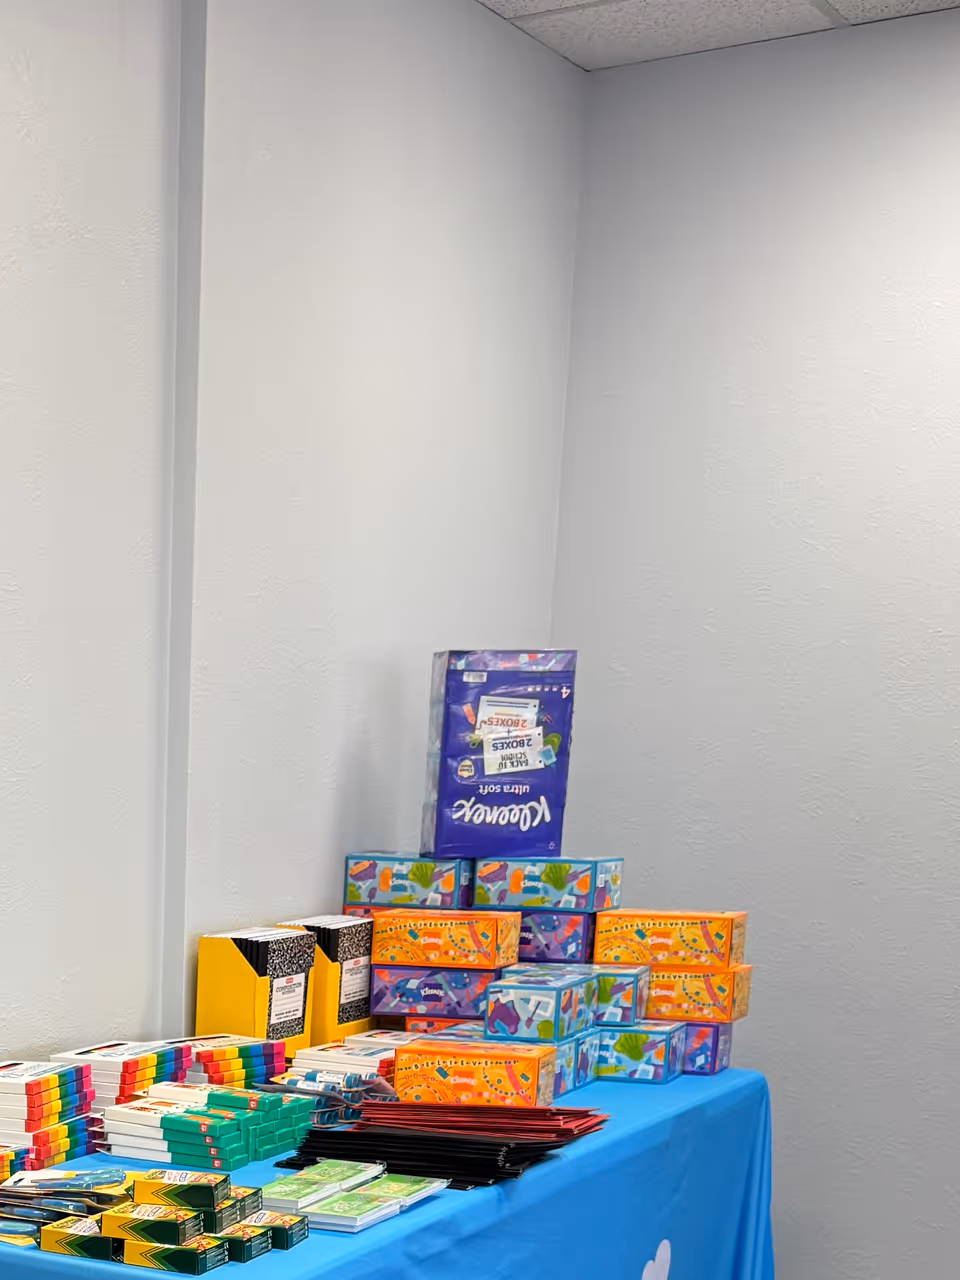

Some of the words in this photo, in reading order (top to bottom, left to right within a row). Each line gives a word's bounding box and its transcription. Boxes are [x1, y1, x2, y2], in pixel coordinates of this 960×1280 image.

[560, 686, 571, 699] 4
[486, 717, 520, 729] BOXES
[520, 720, 528, 728] 2
[491, 738, 525, 751] BOXES
[525, 738, 533, 747] 2
[500, 751, 527, 761] SCHOOL
[498, 760, 510, 770] TO
[512, 758, 529, 768] BACK
[478, 785, 500, 795] soft
[503, 784, 530, 794] ultra
[451, 795, 551, 832] Kleenex
[420, 987, 446, 998] Kleenex
